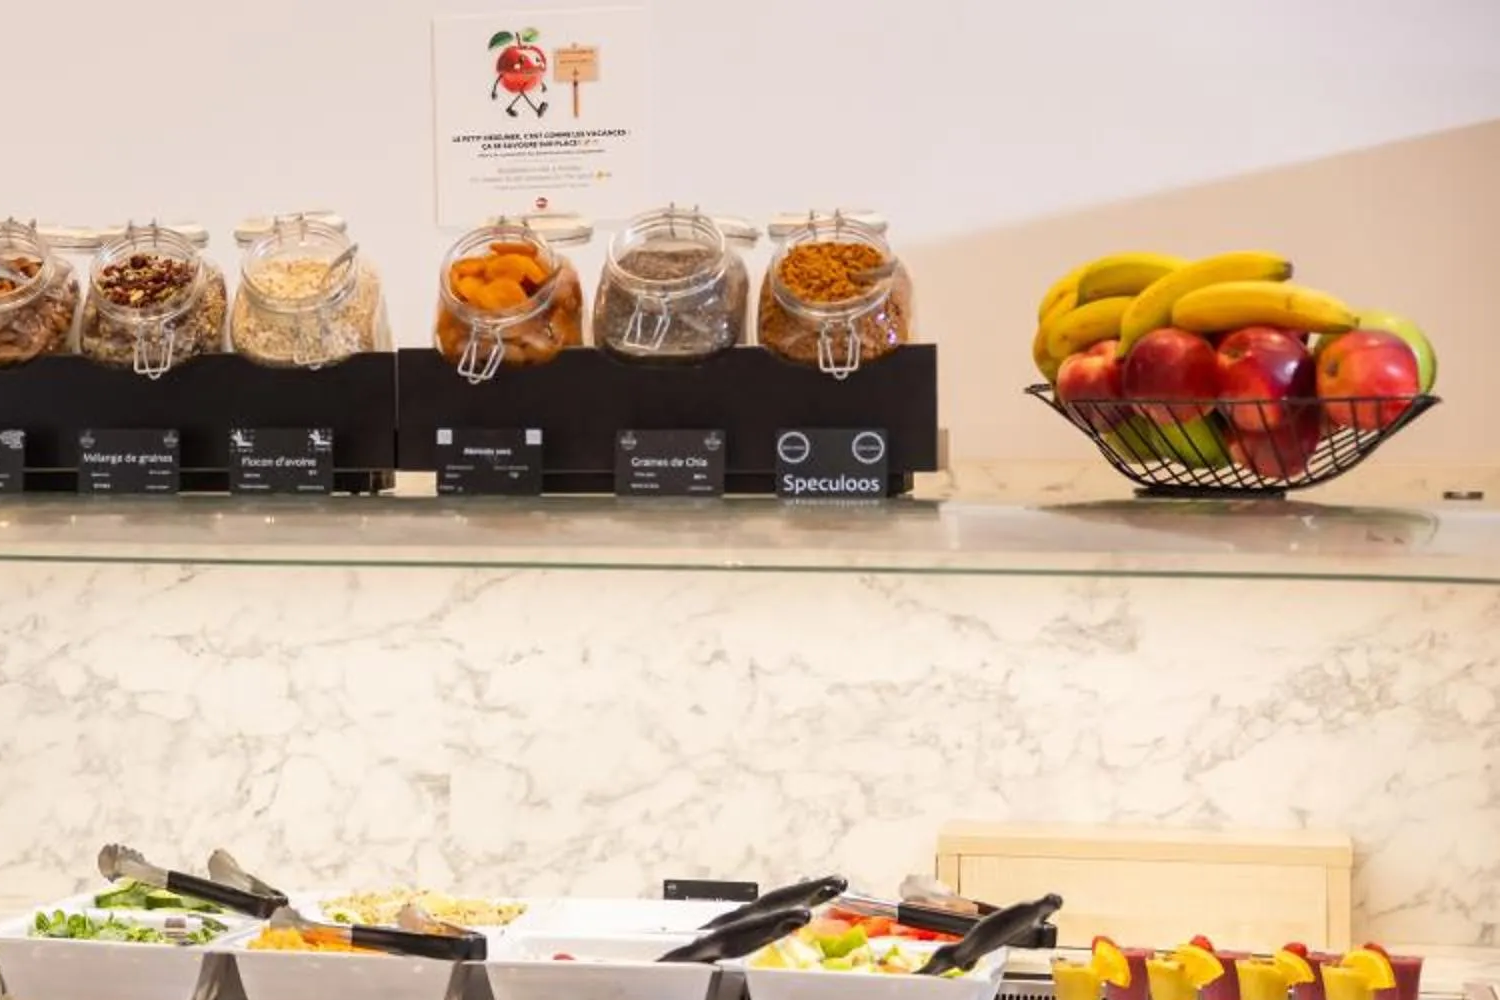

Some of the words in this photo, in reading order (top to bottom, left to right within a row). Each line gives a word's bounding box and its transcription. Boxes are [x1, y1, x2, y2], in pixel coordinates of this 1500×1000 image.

[124, 453, 137, 463] de
[631, 457, 668, 468] Graines
[670, 457, 684, 468] de
[685, 456, 708, 468] Chia
[783, 474, 880, 495] Speculoos
